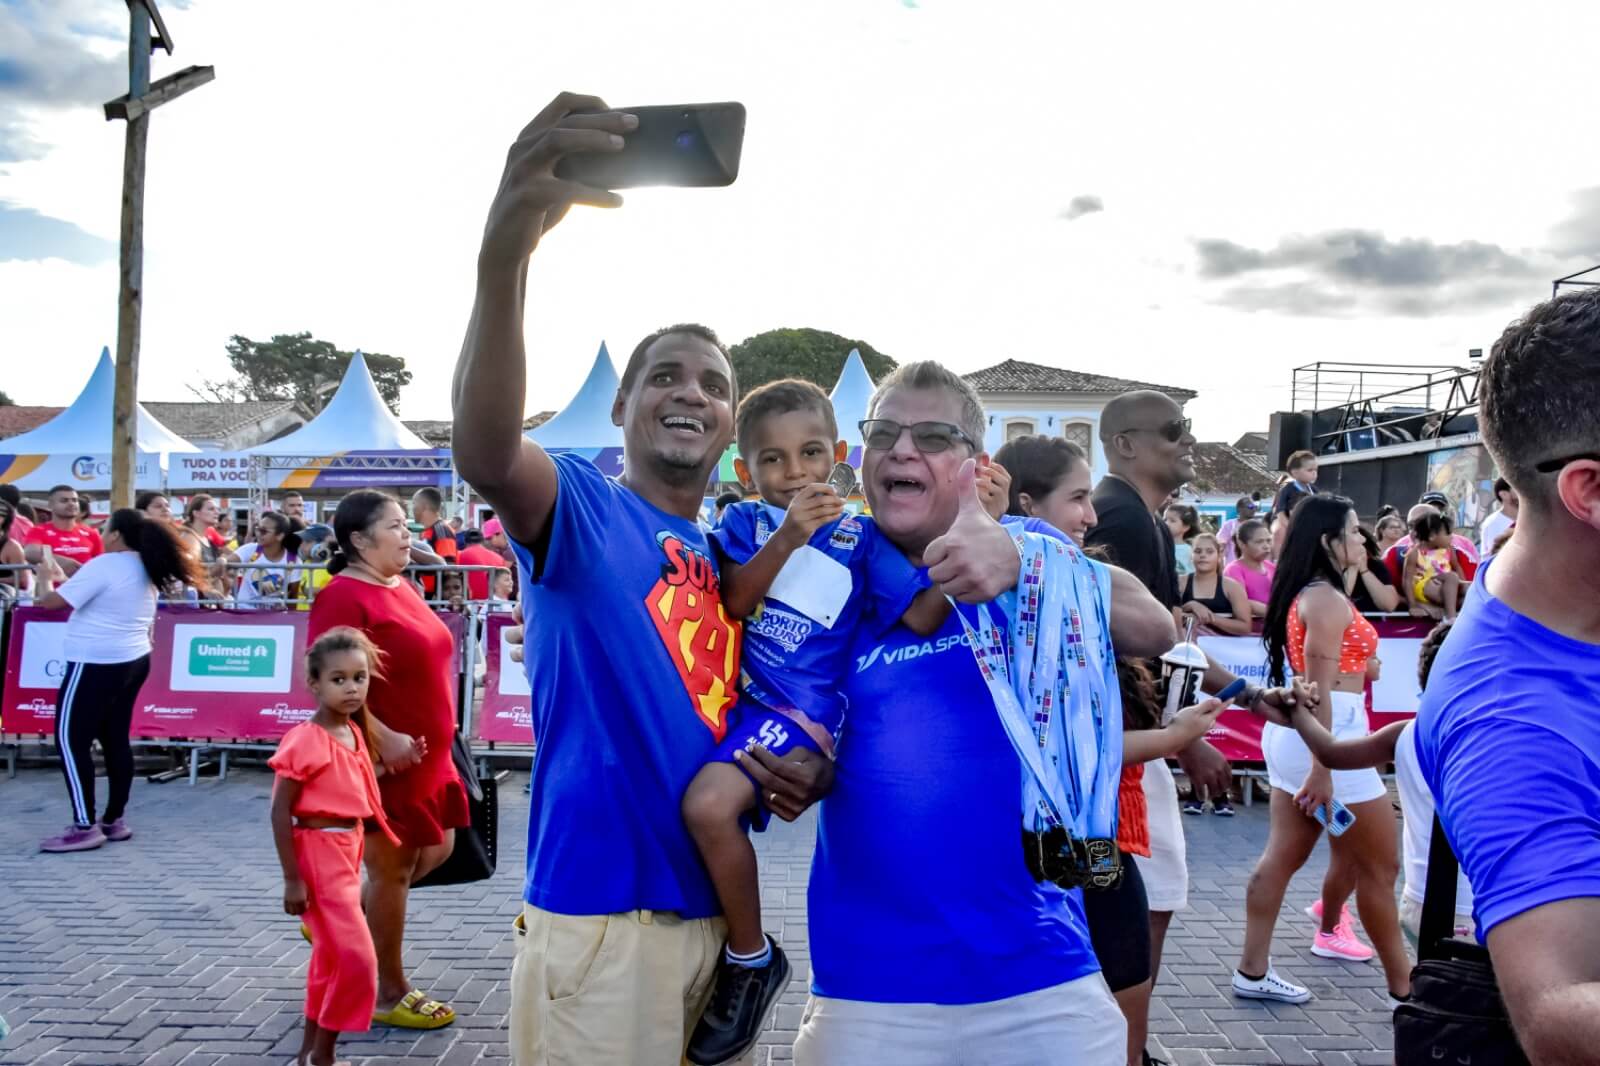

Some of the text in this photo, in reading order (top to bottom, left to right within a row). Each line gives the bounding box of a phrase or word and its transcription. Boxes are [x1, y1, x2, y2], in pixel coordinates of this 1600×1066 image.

[182, 458, 217, 468] TUDO
[220, 458, 237, 468] DE
[191, 471, 216, 481] PRA
[761, 611, 810, 634] PORTO
[197, 644, 251, 656] Unimed
[882, 633, 974, 665] VIDASPO
